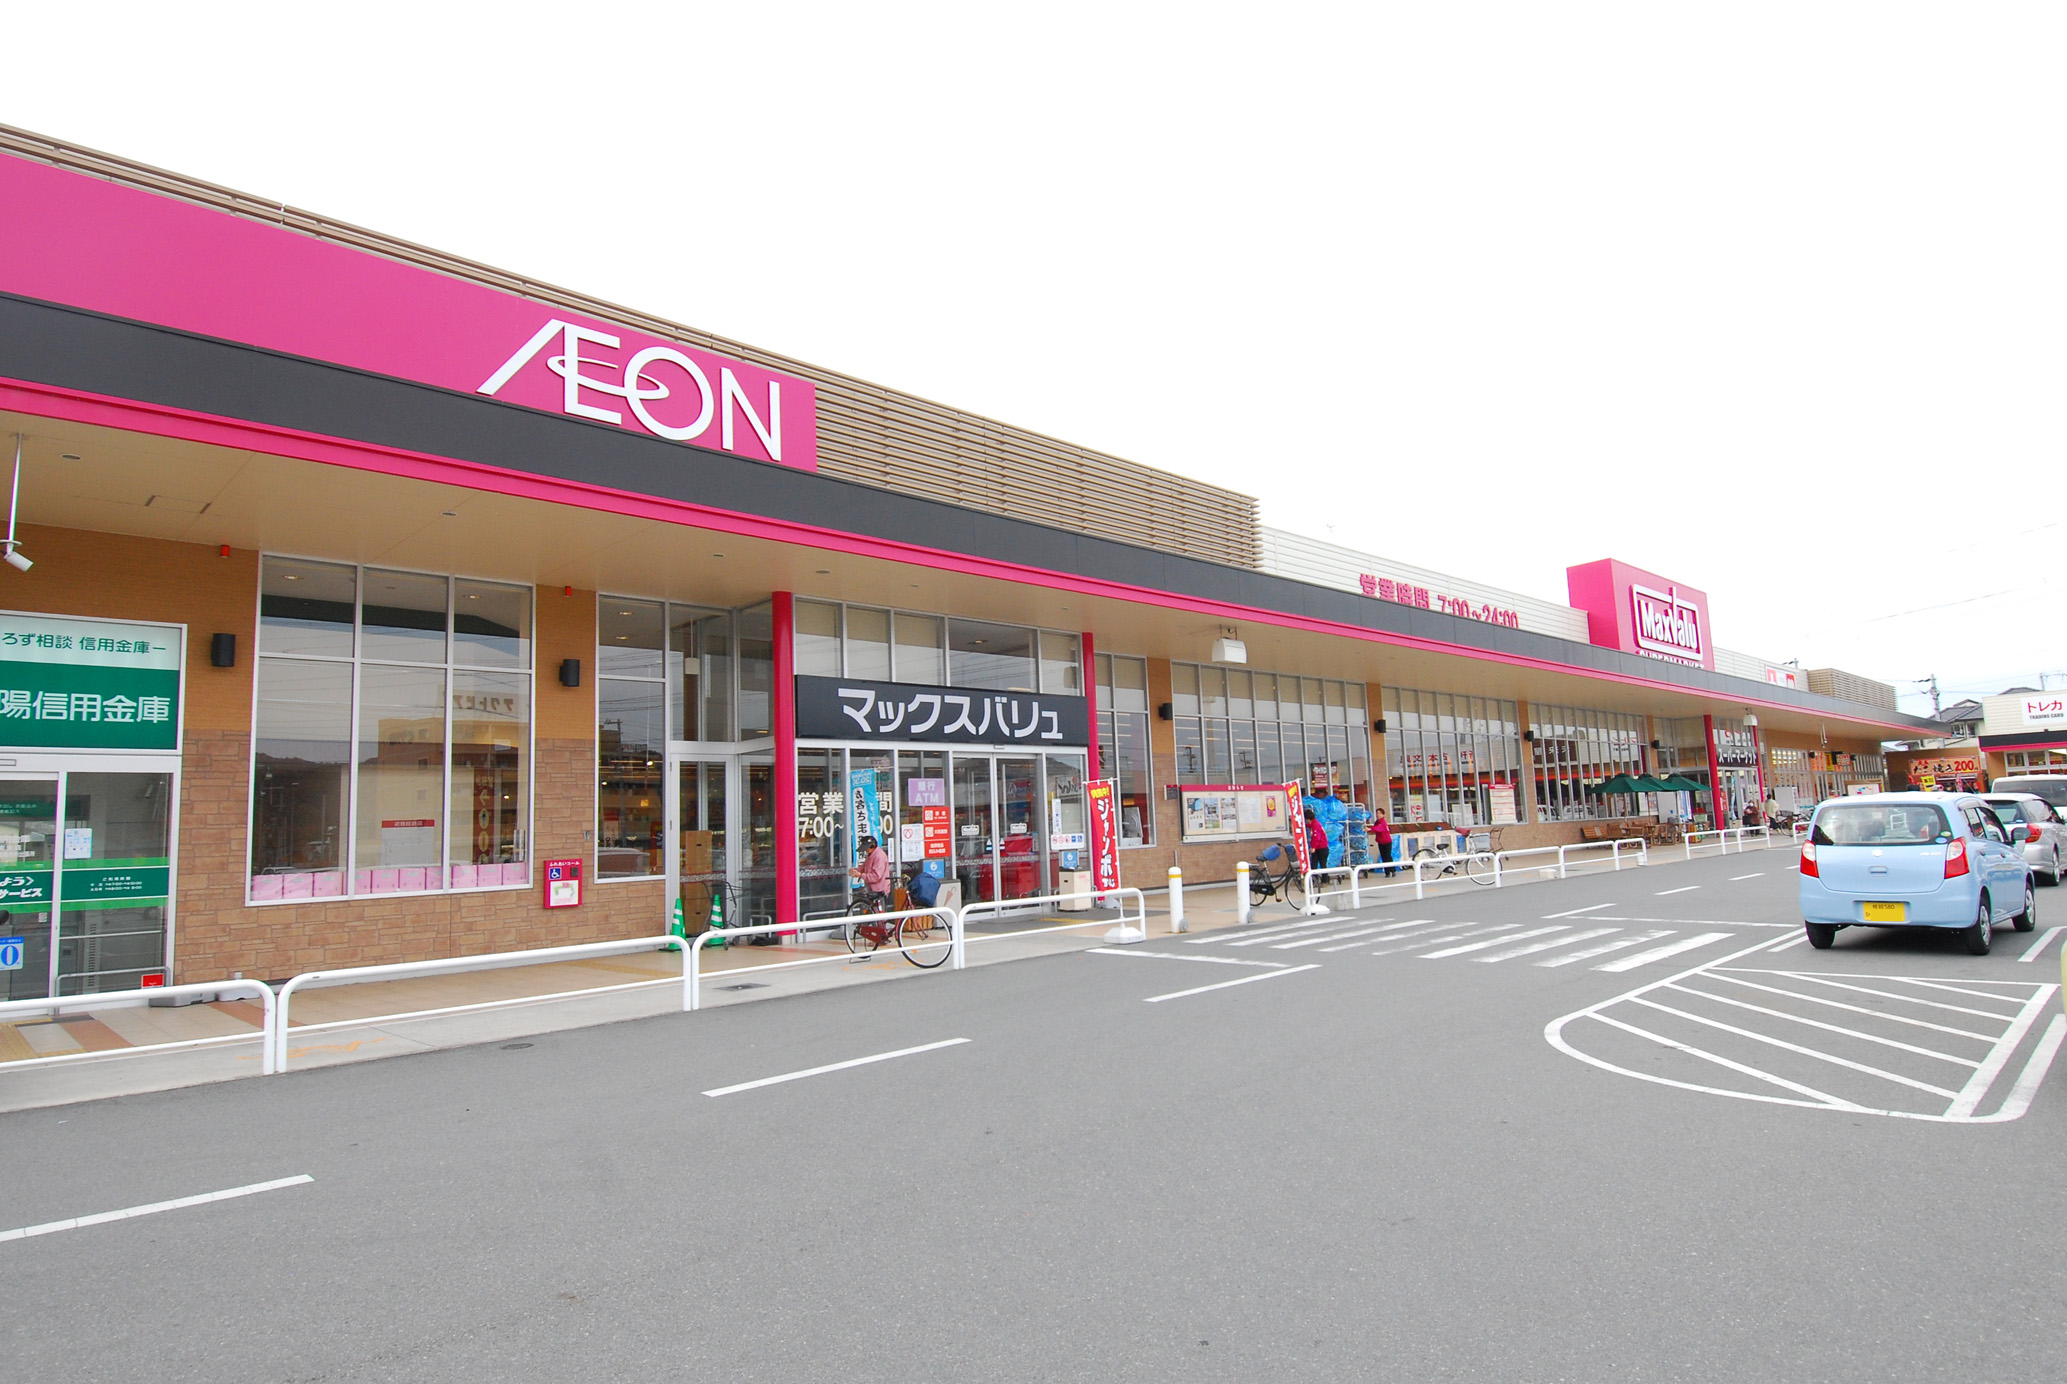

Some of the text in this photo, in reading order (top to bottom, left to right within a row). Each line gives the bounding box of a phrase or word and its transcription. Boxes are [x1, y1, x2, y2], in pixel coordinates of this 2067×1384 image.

[1360, 573, 1430, 610] 営業時間
[1640, 586, 1698, 650] MaxValu
[838, 688, 1063, 740] マックスバリュ
[2027, 699, 2063, 714] トレカ
[799, 791, 893, 815] 営業間
[915, 792, 939, 804] ATM
